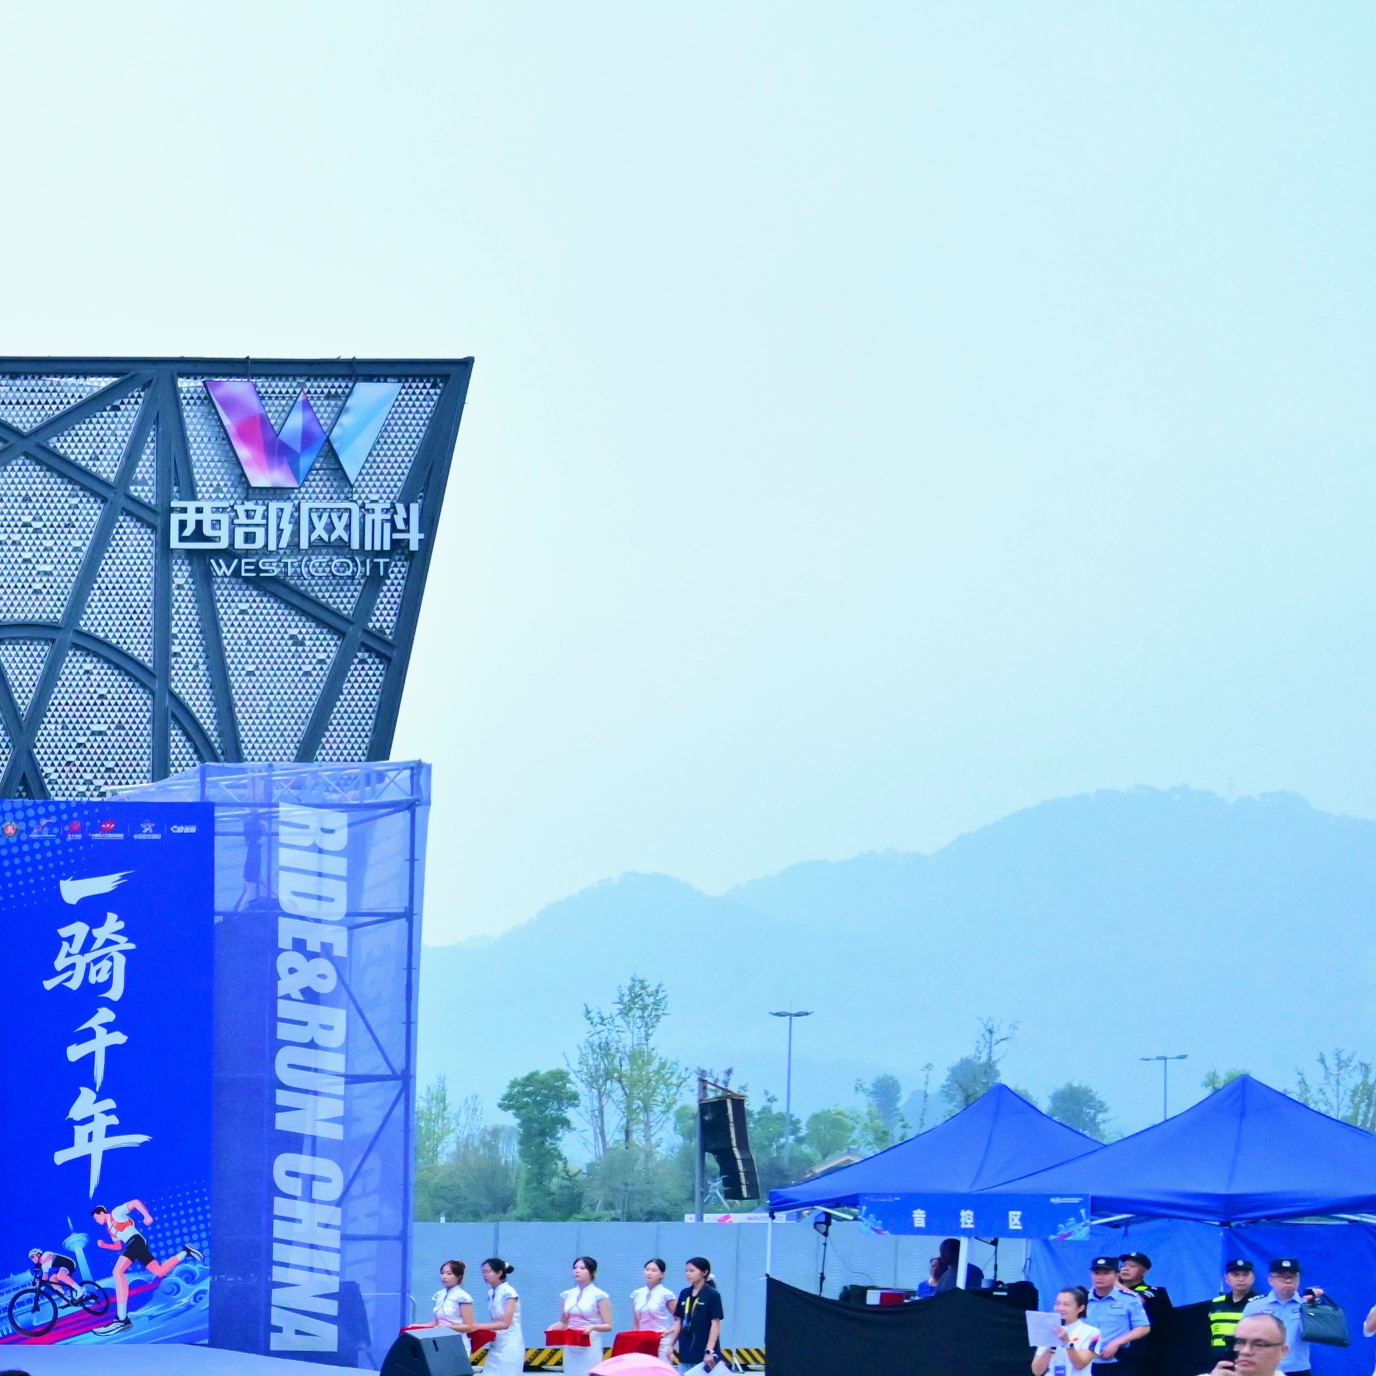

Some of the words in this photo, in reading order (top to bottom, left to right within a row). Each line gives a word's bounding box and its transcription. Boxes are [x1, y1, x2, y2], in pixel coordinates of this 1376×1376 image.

[170, 501, 425, 551] 西部网科
[43, 870, 153, 1200] 一骑千年
[273, 802, 349, 1141] RIDE&RUN
[269, 1151, 346, 1354] CHINA
